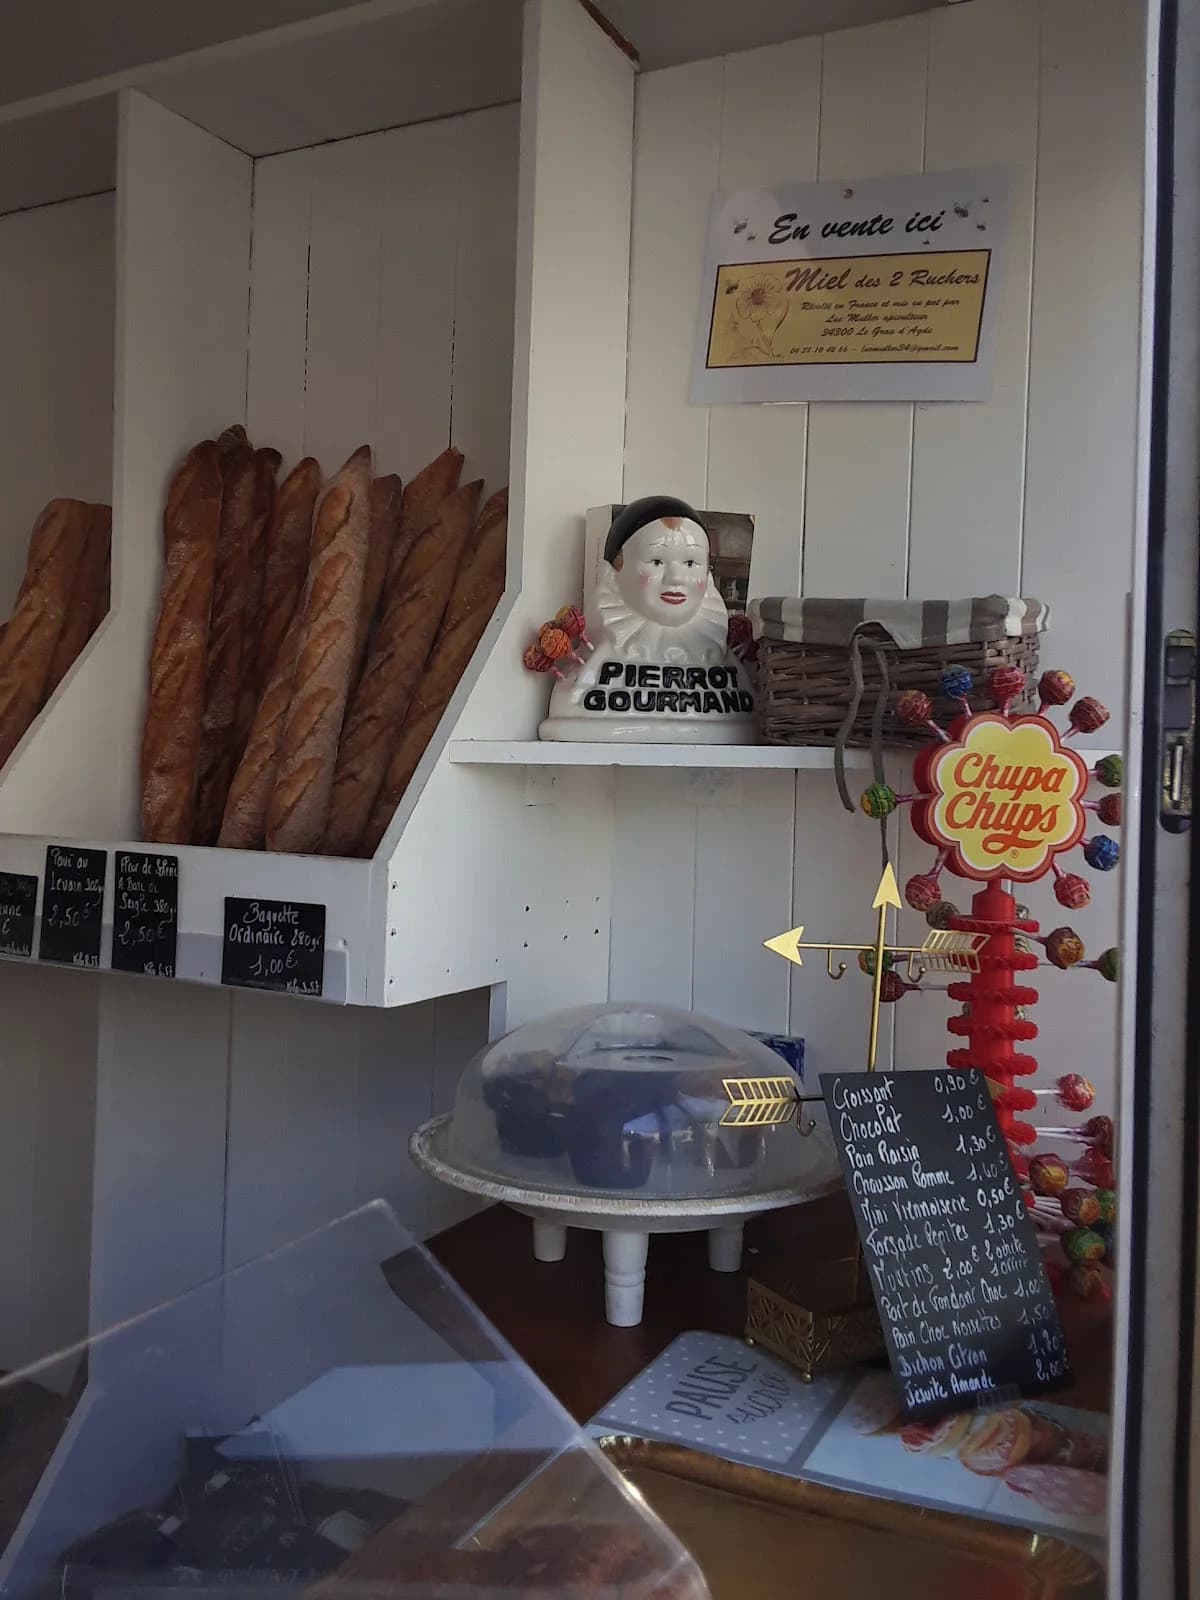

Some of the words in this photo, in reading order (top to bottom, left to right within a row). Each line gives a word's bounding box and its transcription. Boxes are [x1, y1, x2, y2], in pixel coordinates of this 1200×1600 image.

[768, 213, 810, 244] En
[821, 213, 894, 239] vente
[905, 210, 946, 233] ici
[785, 267, 851, 292] Miel
[855, 275, 880, 288] des
[889, 271, 903, 287] 2
[909, 269, 980, 287] Ruchers
[847, 313, 880, 322] Muller
[882, 312, 928, 323] apiculteur
[848, 299, 879, 310] France
[820, 327, 854, 337] 34300
[856, 327, 869, 336] Le
[871, 327, 896, 337] Grau
[599, 662, 738, 689] PIERROT
[584, 690, 754, 713] GOURMAND
[954, 752, 1068, 800] Chupa
[945, 791, 1061, 854] Chups
[243, 902, 300, 931] Baguette
[229, 923, 285, 944] Ordinaire
[832, 1075, 895, 1110] Croissant
[840, 1104, 902, 1142] Chocolat
[845, 1143, 875, 1169] Pain
[878, 1137, 921, 1165] Raisin
[853, 1170, 909, 1195] Chausson
[912, 1161, 955, 1189] Pomme
[860, 1197, 889, 1230] Mini
[892, 1191, 970, 1221] Viennoiserie
[980, 1278, 1008, 1303] Choc
[892, 1325, 916, 1349] Pain
[920, 1321, 951, 1345] Choc
[948, 1342, 988, 1369] Citron
[666, 1355, 758, 1420] PAUSE
[950, 1368, 996, 1394] Amande
